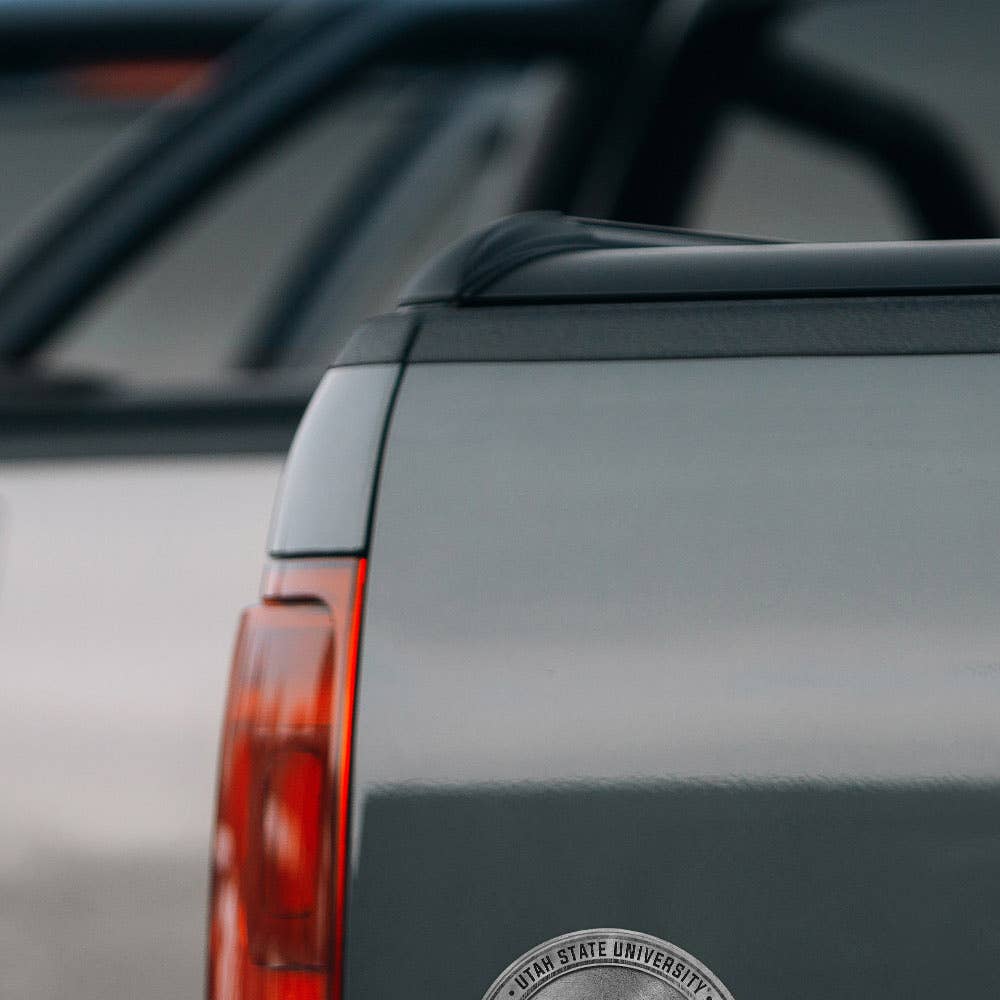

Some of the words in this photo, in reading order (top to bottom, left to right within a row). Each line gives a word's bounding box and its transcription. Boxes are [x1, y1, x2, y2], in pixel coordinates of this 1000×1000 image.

[514, 955, 555, 990] UTAH
[557, 941, 607, 965] STATE
[613, 941, 707, 994] UNIVERSITY
